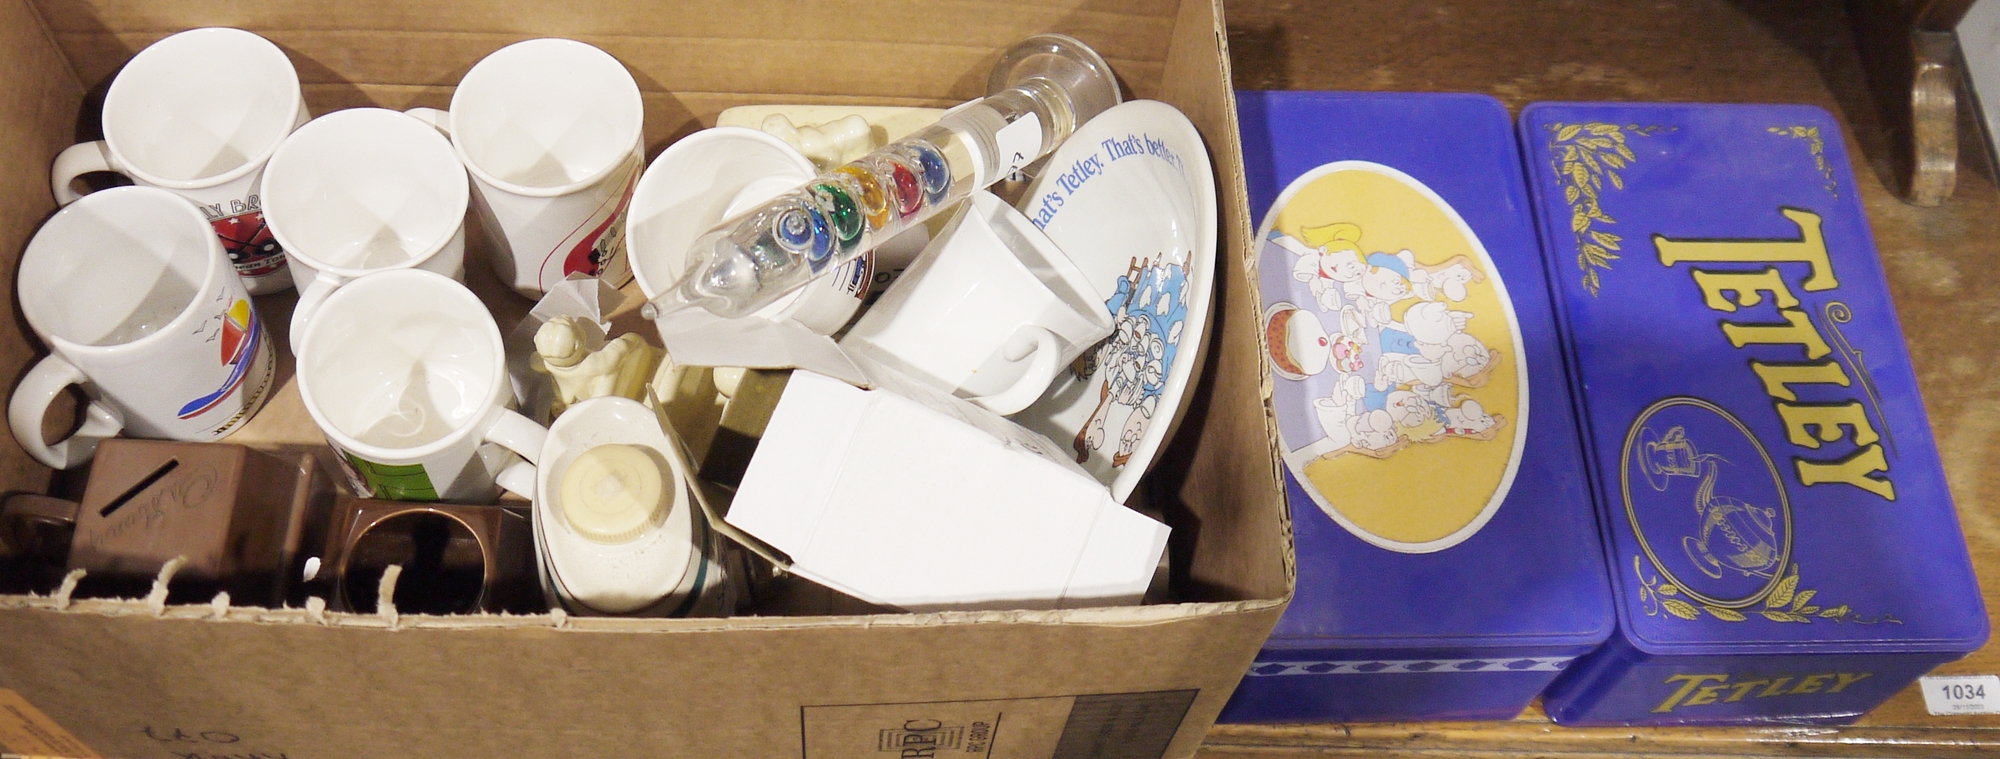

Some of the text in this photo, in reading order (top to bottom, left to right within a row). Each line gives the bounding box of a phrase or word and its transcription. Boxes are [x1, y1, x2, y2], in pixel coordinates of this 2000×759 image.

[1056, 153, 1104, 196] Tetley.
[1101, 133, 1144, 161] That's
[1653, 207, 1896, 501] TETLEY
[1650, 673, 1873, 713] TETLEY
[1942, 684, 1986, 700] 1034
[901, 719, 942, 759] RPC
